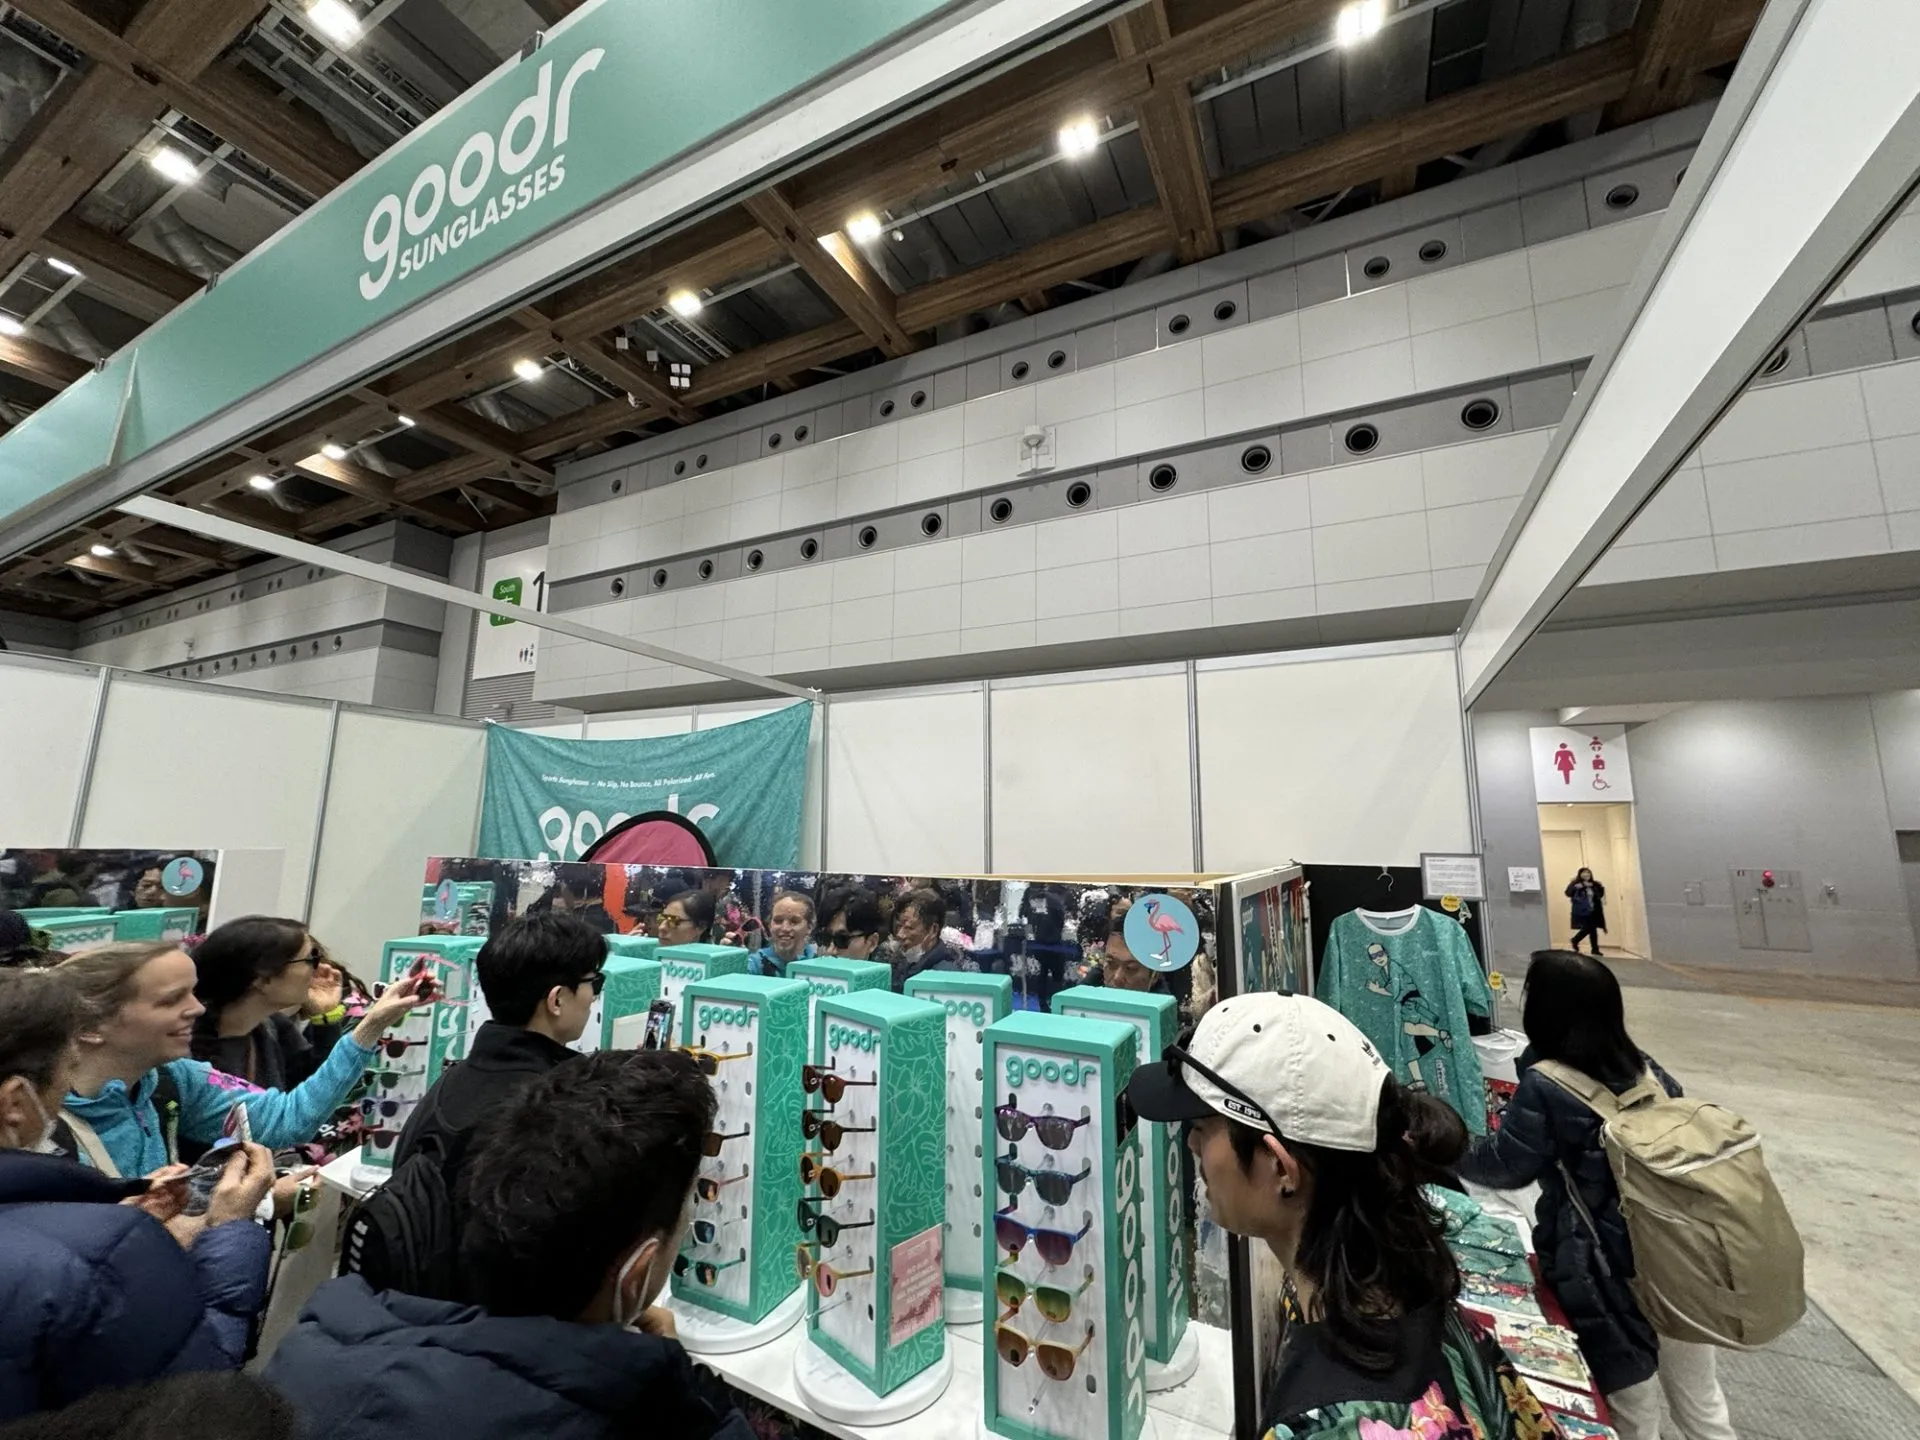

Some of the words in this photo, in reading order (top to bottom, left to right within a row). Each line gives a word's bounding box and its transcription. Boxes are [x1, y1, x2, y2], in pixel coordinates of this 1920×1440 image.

[359, 48, 606, 301] goodr
[398, 154, 566, 280] SUNGLASSES
[698, 1003, 758, 1031] goodr
[828, 1023, 881, 1053] goodr
[1005, 1055, 1097, 1088] goodr
[1115, 1146, 1145, 1417] goodr
